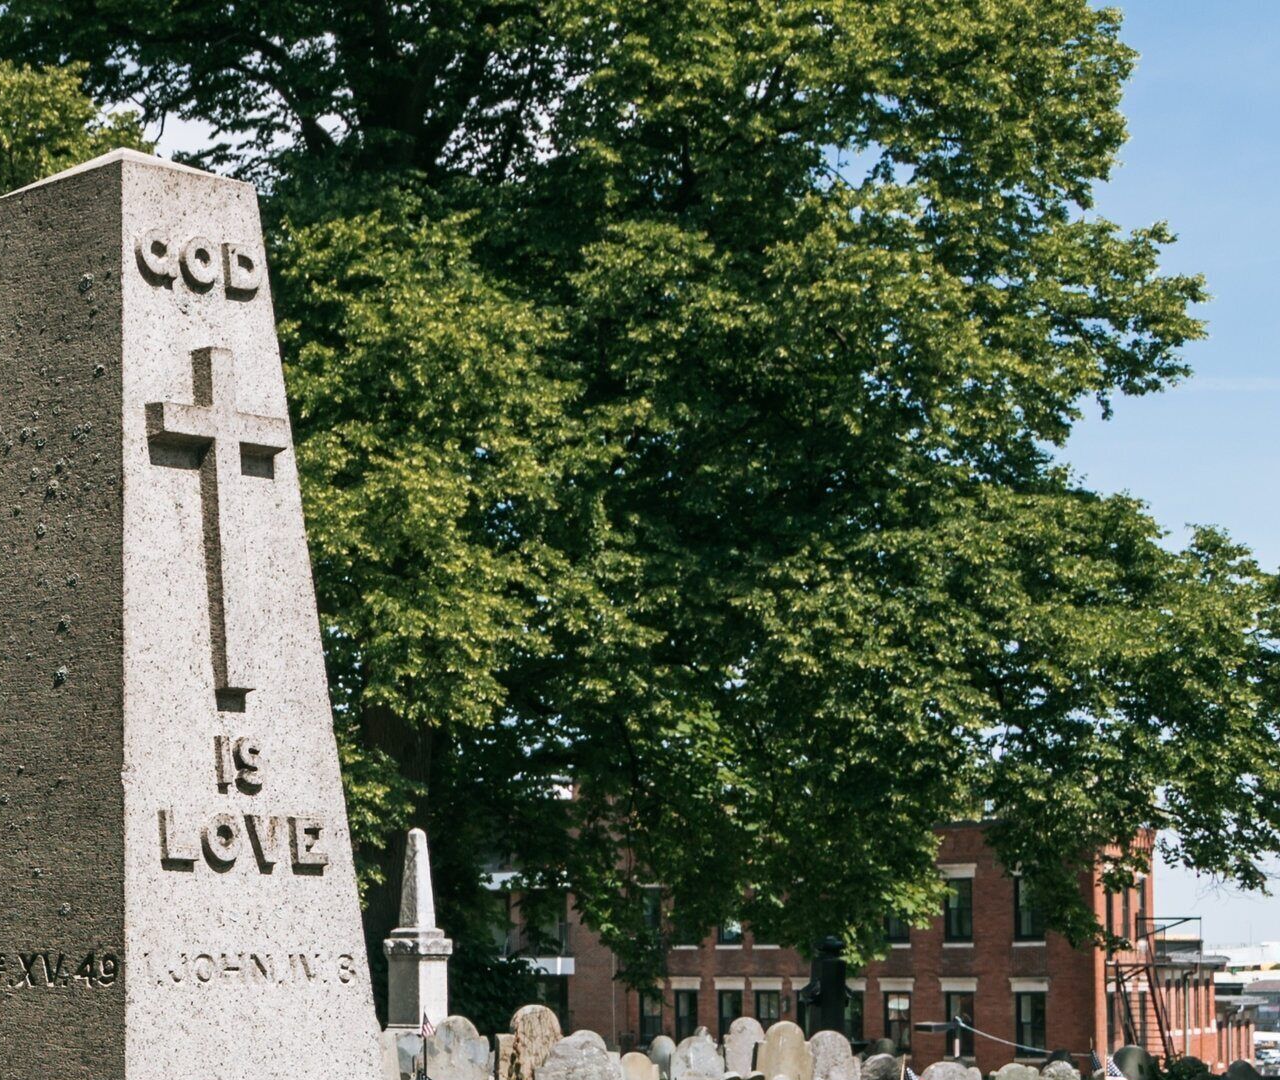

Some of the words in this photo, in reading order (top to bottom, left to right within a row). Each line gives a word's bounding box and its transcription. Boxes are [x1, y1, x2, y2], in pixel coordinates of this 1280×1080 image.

[134, 229, 262, 302] GOD
[214, 734, 265, 796] IS
[157, 808, 329, 876] LOVE
